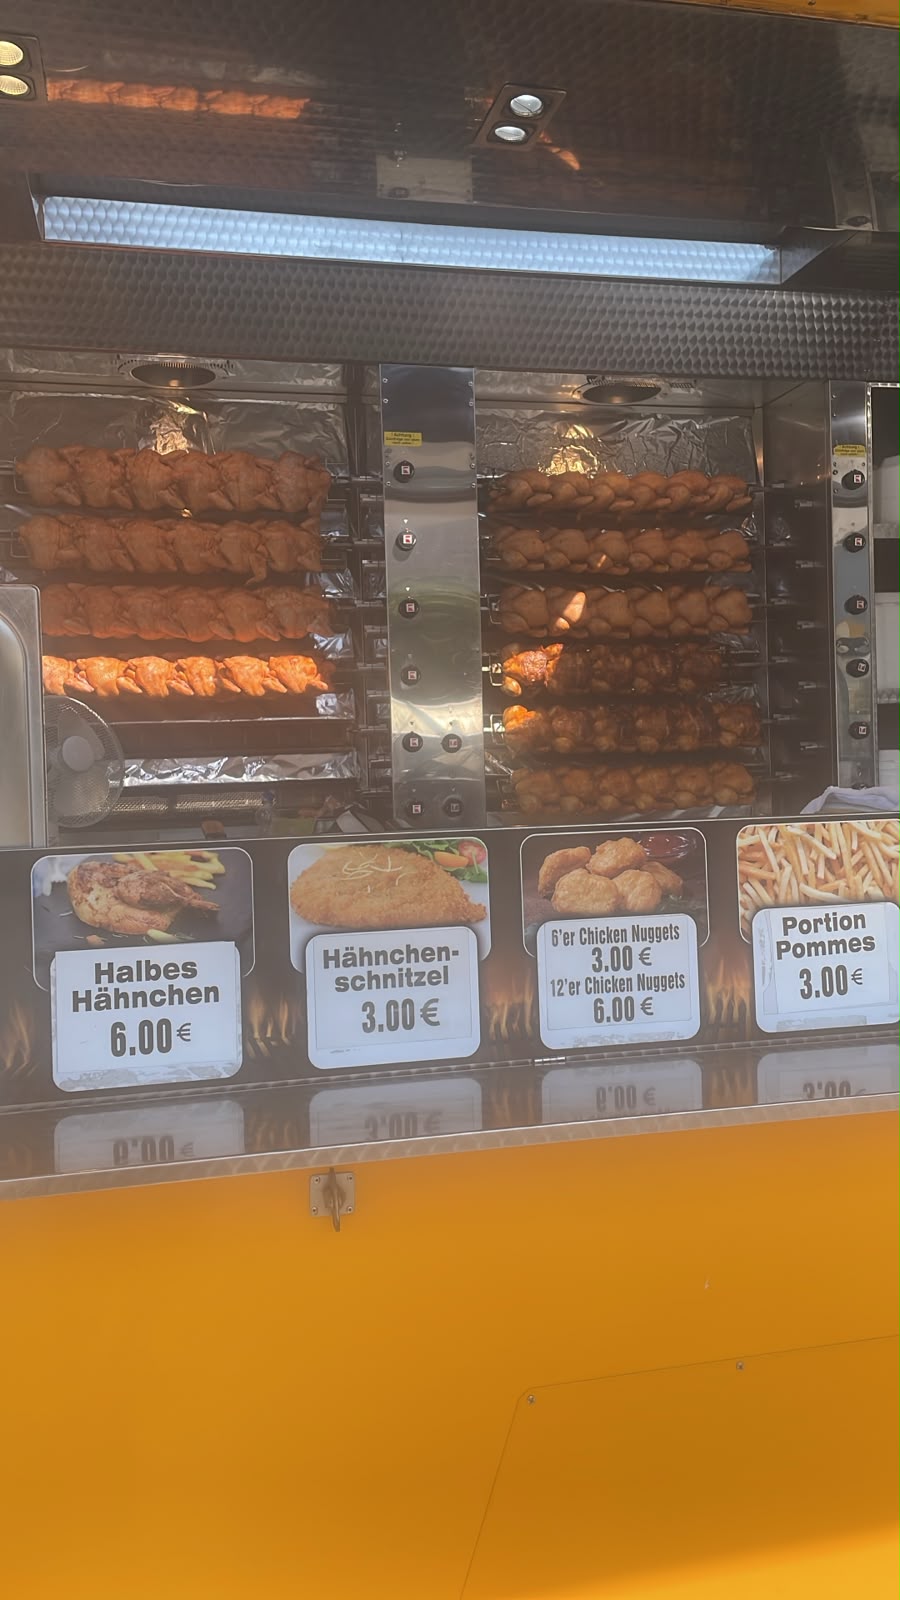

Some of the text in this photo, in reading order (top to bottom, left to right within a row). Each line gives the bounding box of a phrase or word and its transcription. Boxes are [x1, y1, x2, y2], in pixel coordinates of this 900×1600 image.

[551, 923, 680, 947] 6'er Chicken Nuggets
[782, 911, 866, 937] Portion
[323, 945, 459, 970] Hähnchen-
[591, 945, 633, 973] 3.00
[776, 935, 876, 961] Pommes
[94, 958, 198, 985] Halbes
[334, 965, 449, 993] schnitzel
[550, 971, 686, 997] 12'er Chicken Nuggets
[72, 983, 220, 1013] Hähnchen
[593, 995, 635, 1024] 6.00
